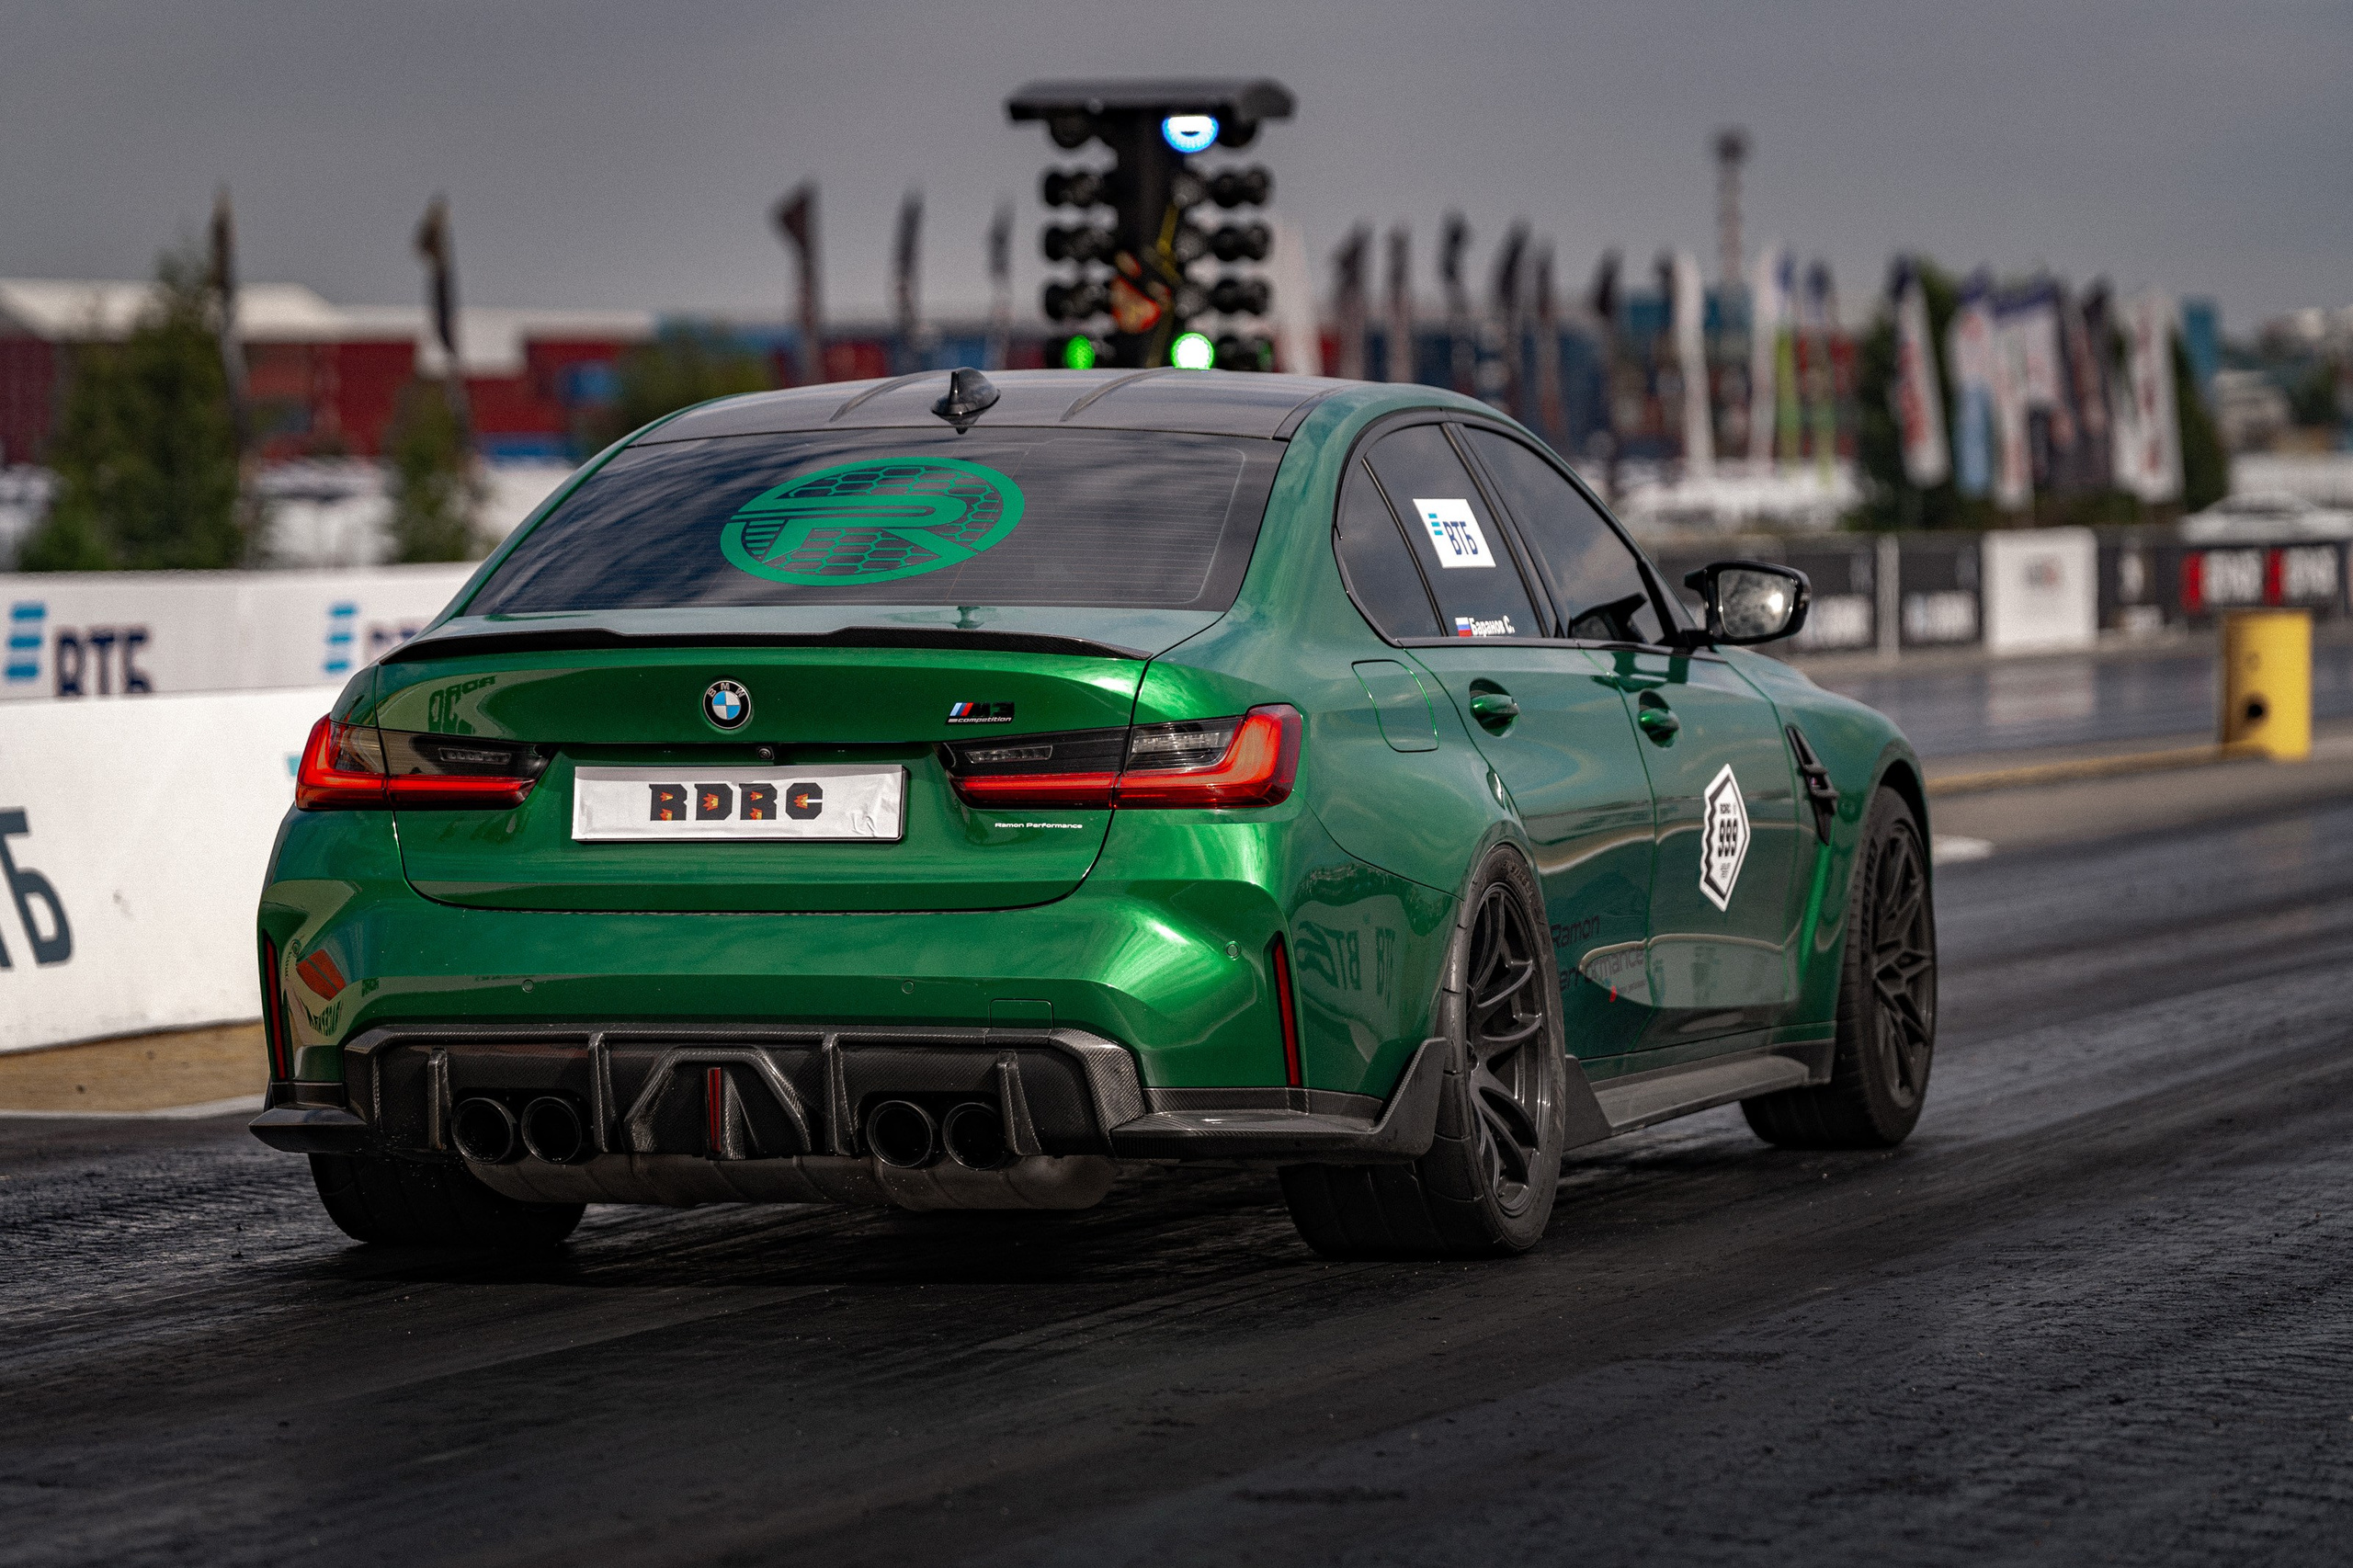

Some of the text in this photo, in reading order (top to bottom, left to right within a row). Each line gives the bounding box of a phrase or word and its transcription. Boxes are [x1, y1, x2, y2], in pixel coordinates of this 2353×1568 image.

[1442, 521, 1479, 555] ВТБ
[1468, 617, 1506, 637] Баранов
[707, 682, 745, 699] BMW
[971, 702, 1015, 717] M3
[649, 782, 824, 821] RDRC
[1718, 818, 1737, 857] 999
[1550, 915, 1600, 948] Ramon
